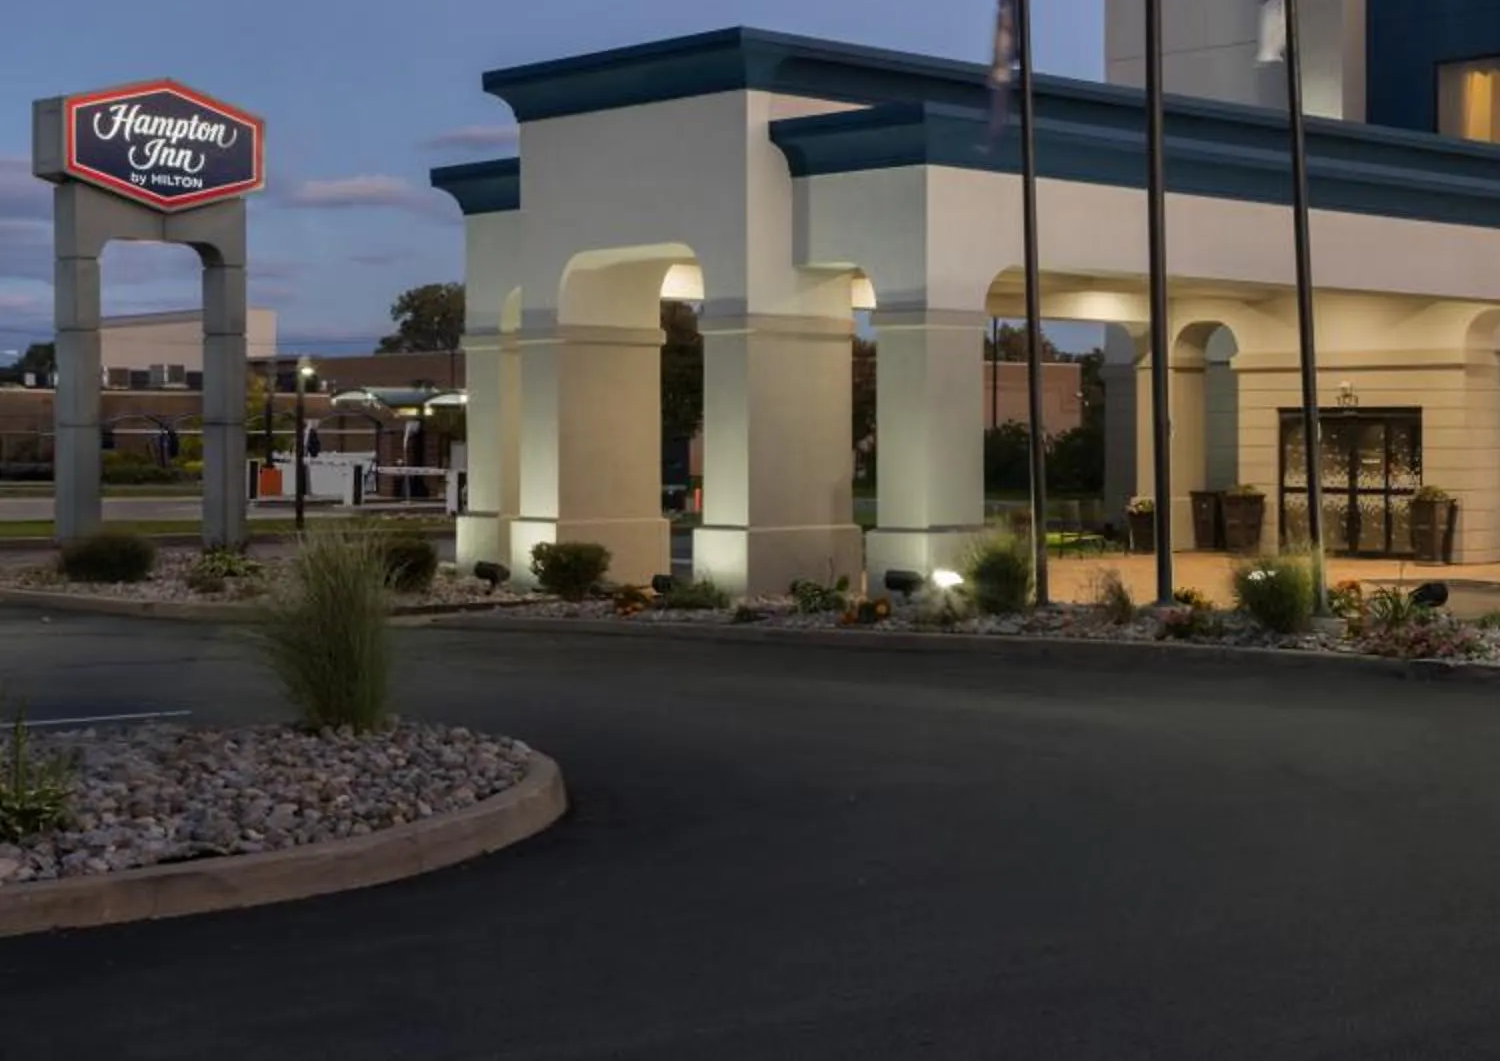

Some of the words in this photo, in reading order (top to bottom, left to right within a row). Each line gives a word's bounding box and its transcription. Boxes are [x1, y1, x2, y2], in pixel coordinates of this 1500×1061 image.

[93, 104, 237, 148] Hampton
[128, 139, 205, 172] Inn
[130, 172, 147, 185] by
[151, 176, 203, 189] HILTON
